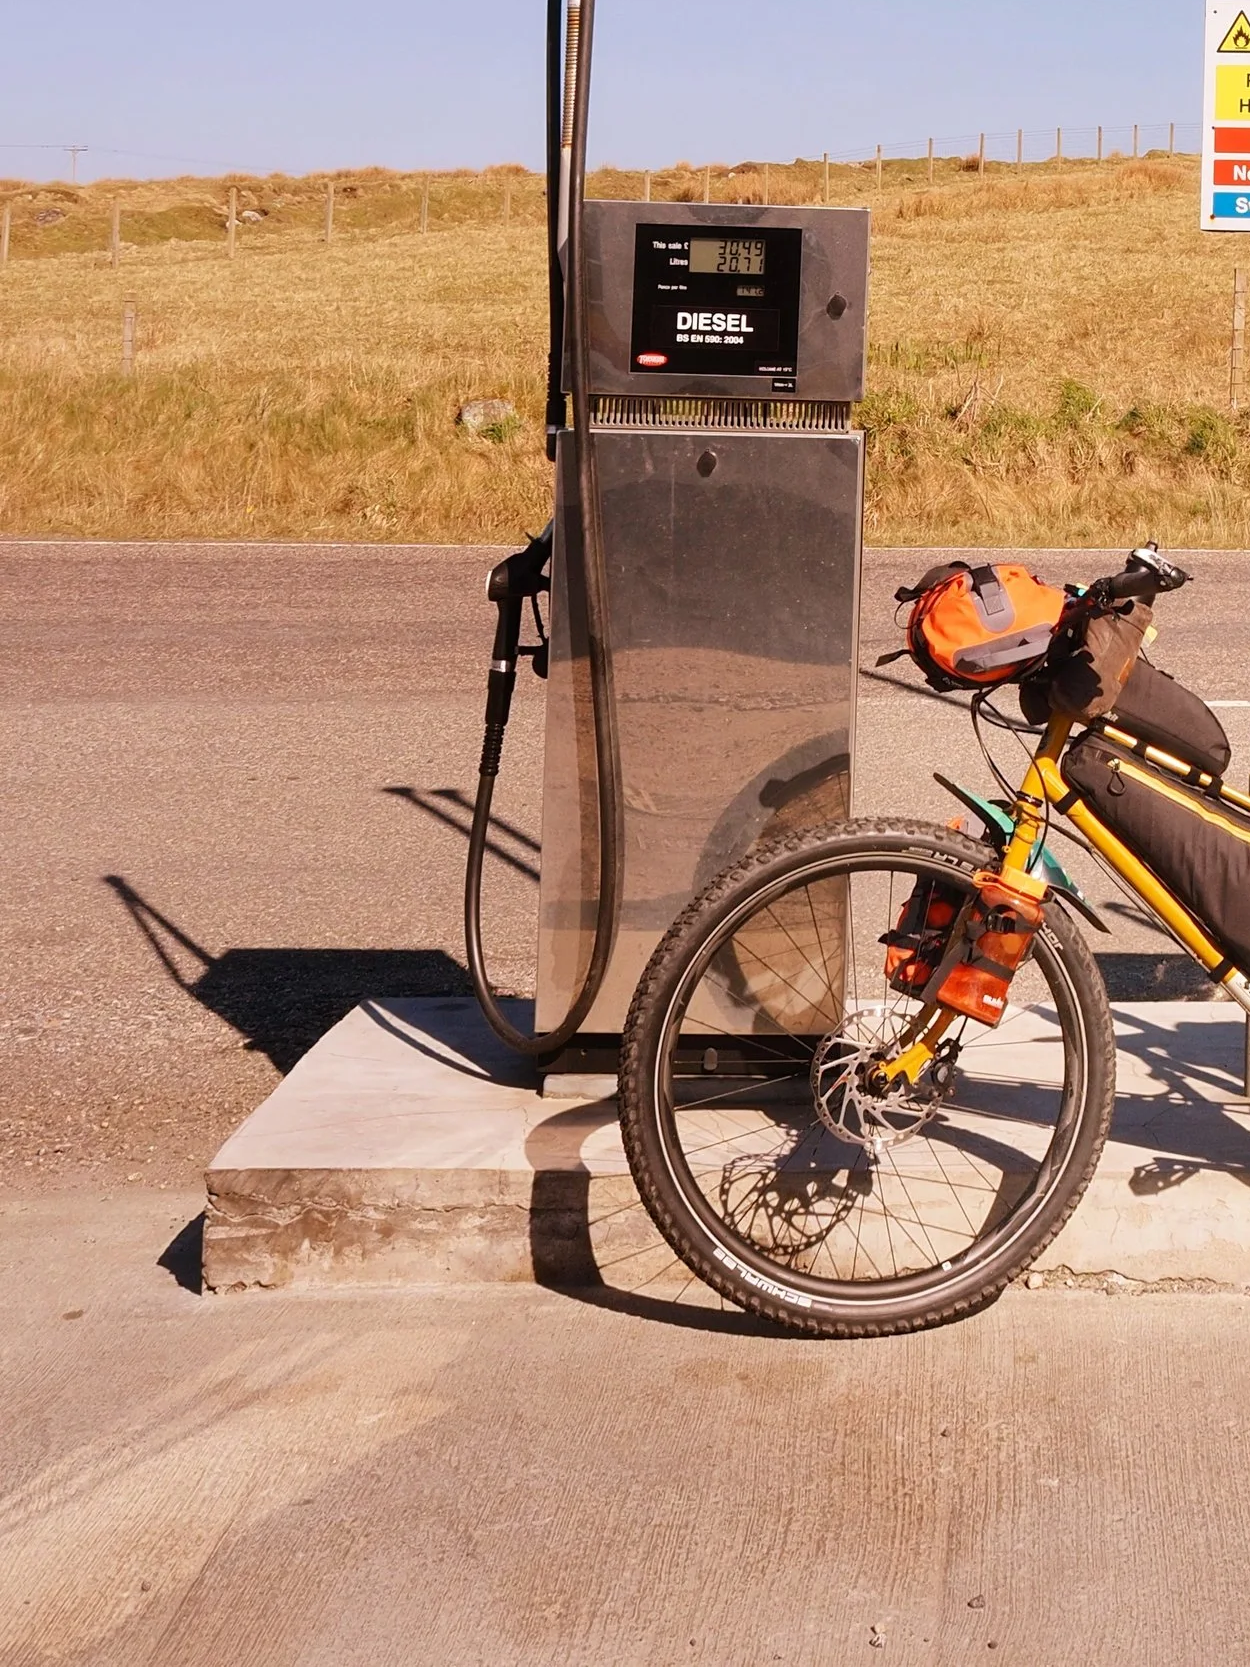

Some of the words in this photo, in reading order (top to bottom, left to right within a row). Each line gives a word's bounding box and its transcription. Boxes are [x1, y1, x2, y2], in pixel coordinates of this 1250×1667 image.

[652, 241, 667, 250] This
[668, 242, 683, 250] sale
[718, 240, 764, 256] 30.49
[669, 258, 689, 266] Litres
[717, 256, 764, 273] 20.71
[677, 312, 754, 332] DIESEL
[676, 334, 689, 342] BS
[690, 334, 703, 343] EN
[705, 335, 723, 343] 590:
[723, 336, 744, 344] 2004
[712, 1247, 812, 1309] SCHWALBE
